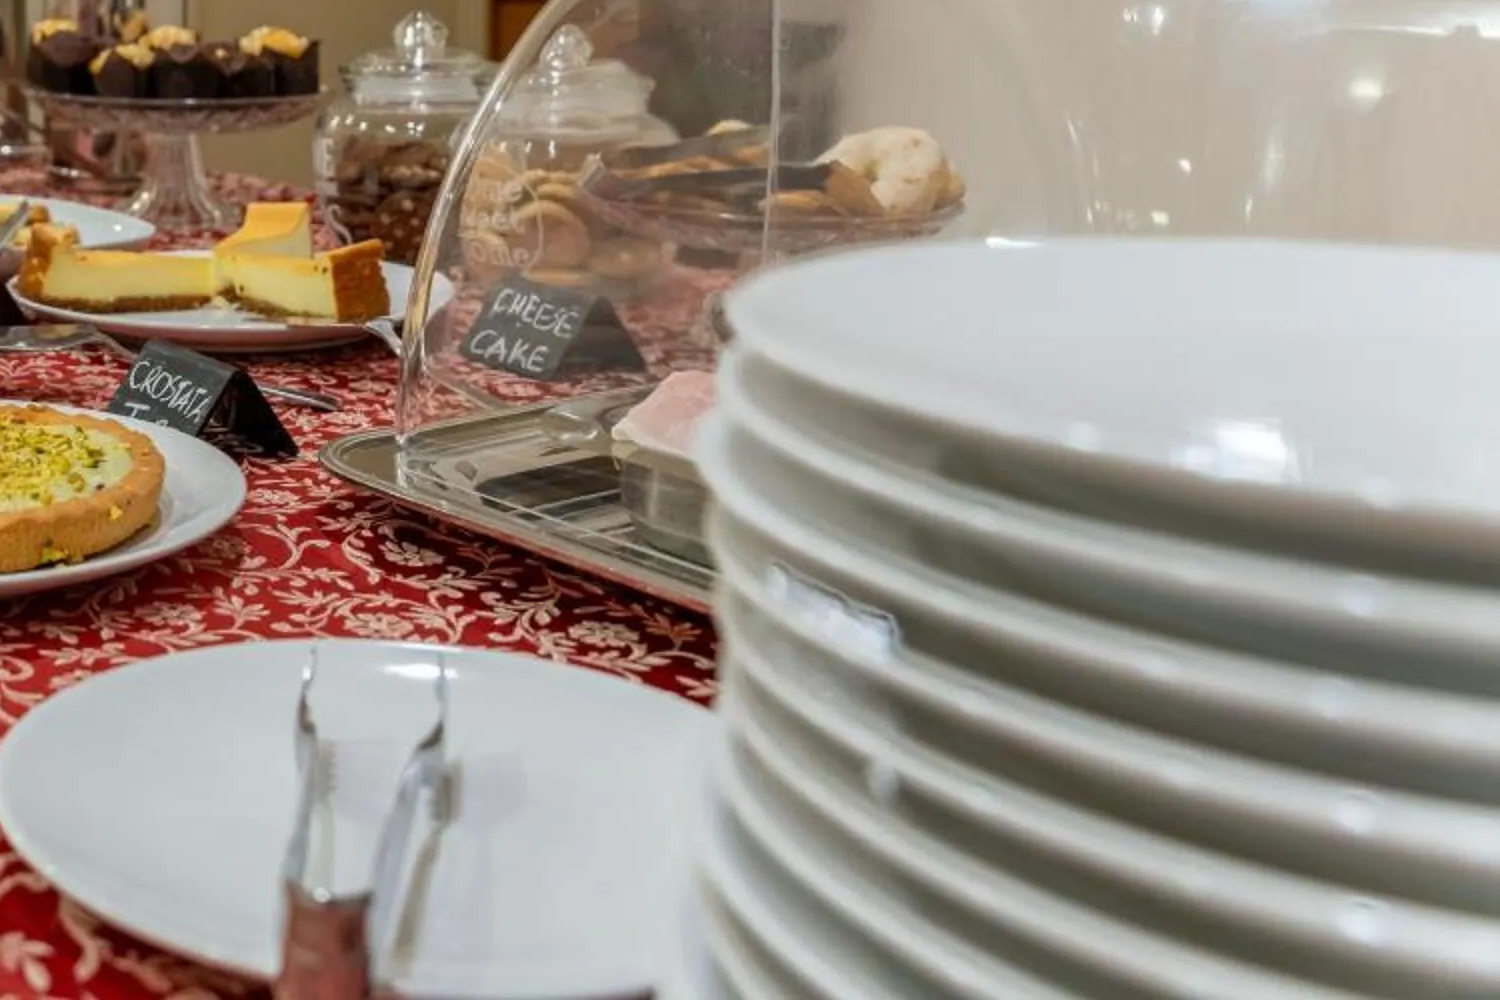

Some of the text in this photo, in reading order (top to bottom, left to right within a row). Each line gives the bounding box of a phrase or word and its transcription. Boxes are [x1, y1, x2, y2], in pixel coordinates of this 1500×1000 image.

[489, 287, 580, 338] CHEESE
[470, 329, 549, 373] CAKE
[129, 360, 212, 424] CROSTATA
